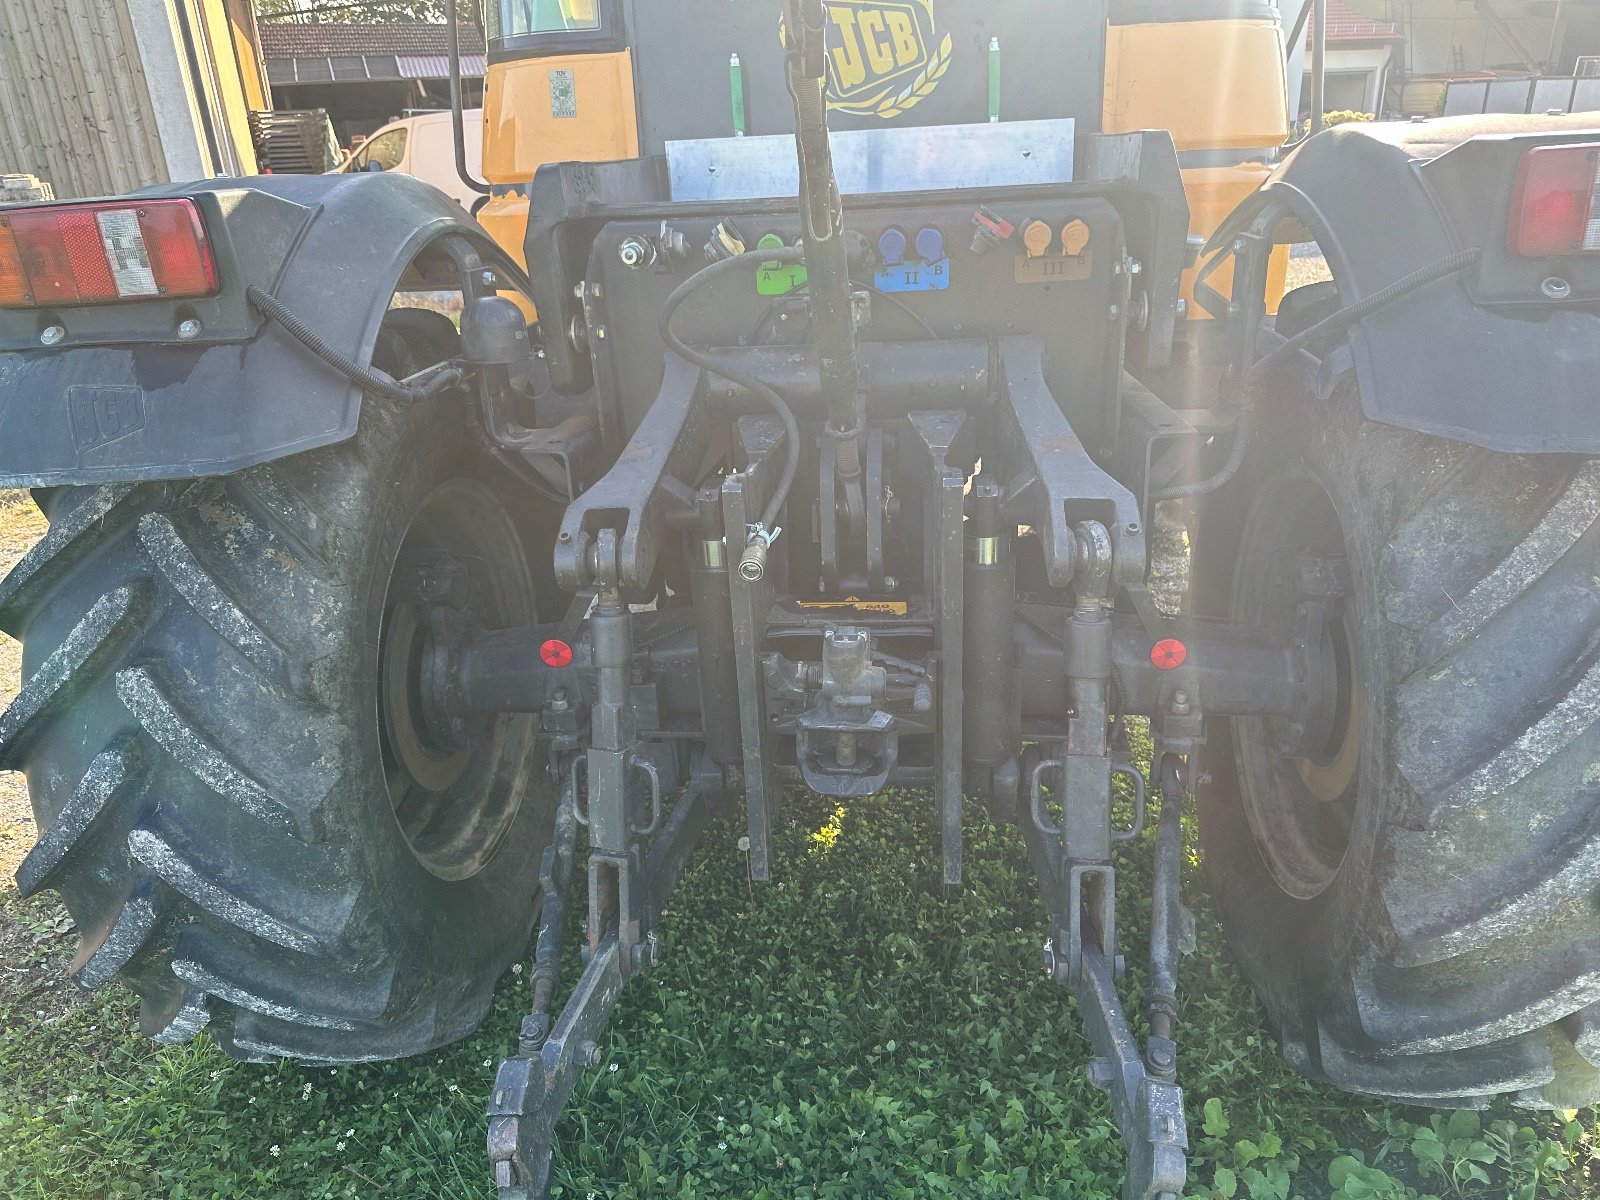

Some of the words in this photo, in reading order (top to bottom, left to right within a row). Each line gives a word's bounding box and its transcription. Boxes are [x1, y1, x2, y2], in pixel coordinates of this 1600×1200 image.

[829, 6, 919, 89] JCB
[763, 271, 770, 280] A
[905, 271, 920, 285] II
[934, 265, 942, 275] B
[1023, 259, 1030, 268] A
[1042, 262, 1064, 276] III
[75, 390, 138, 446] JCB
